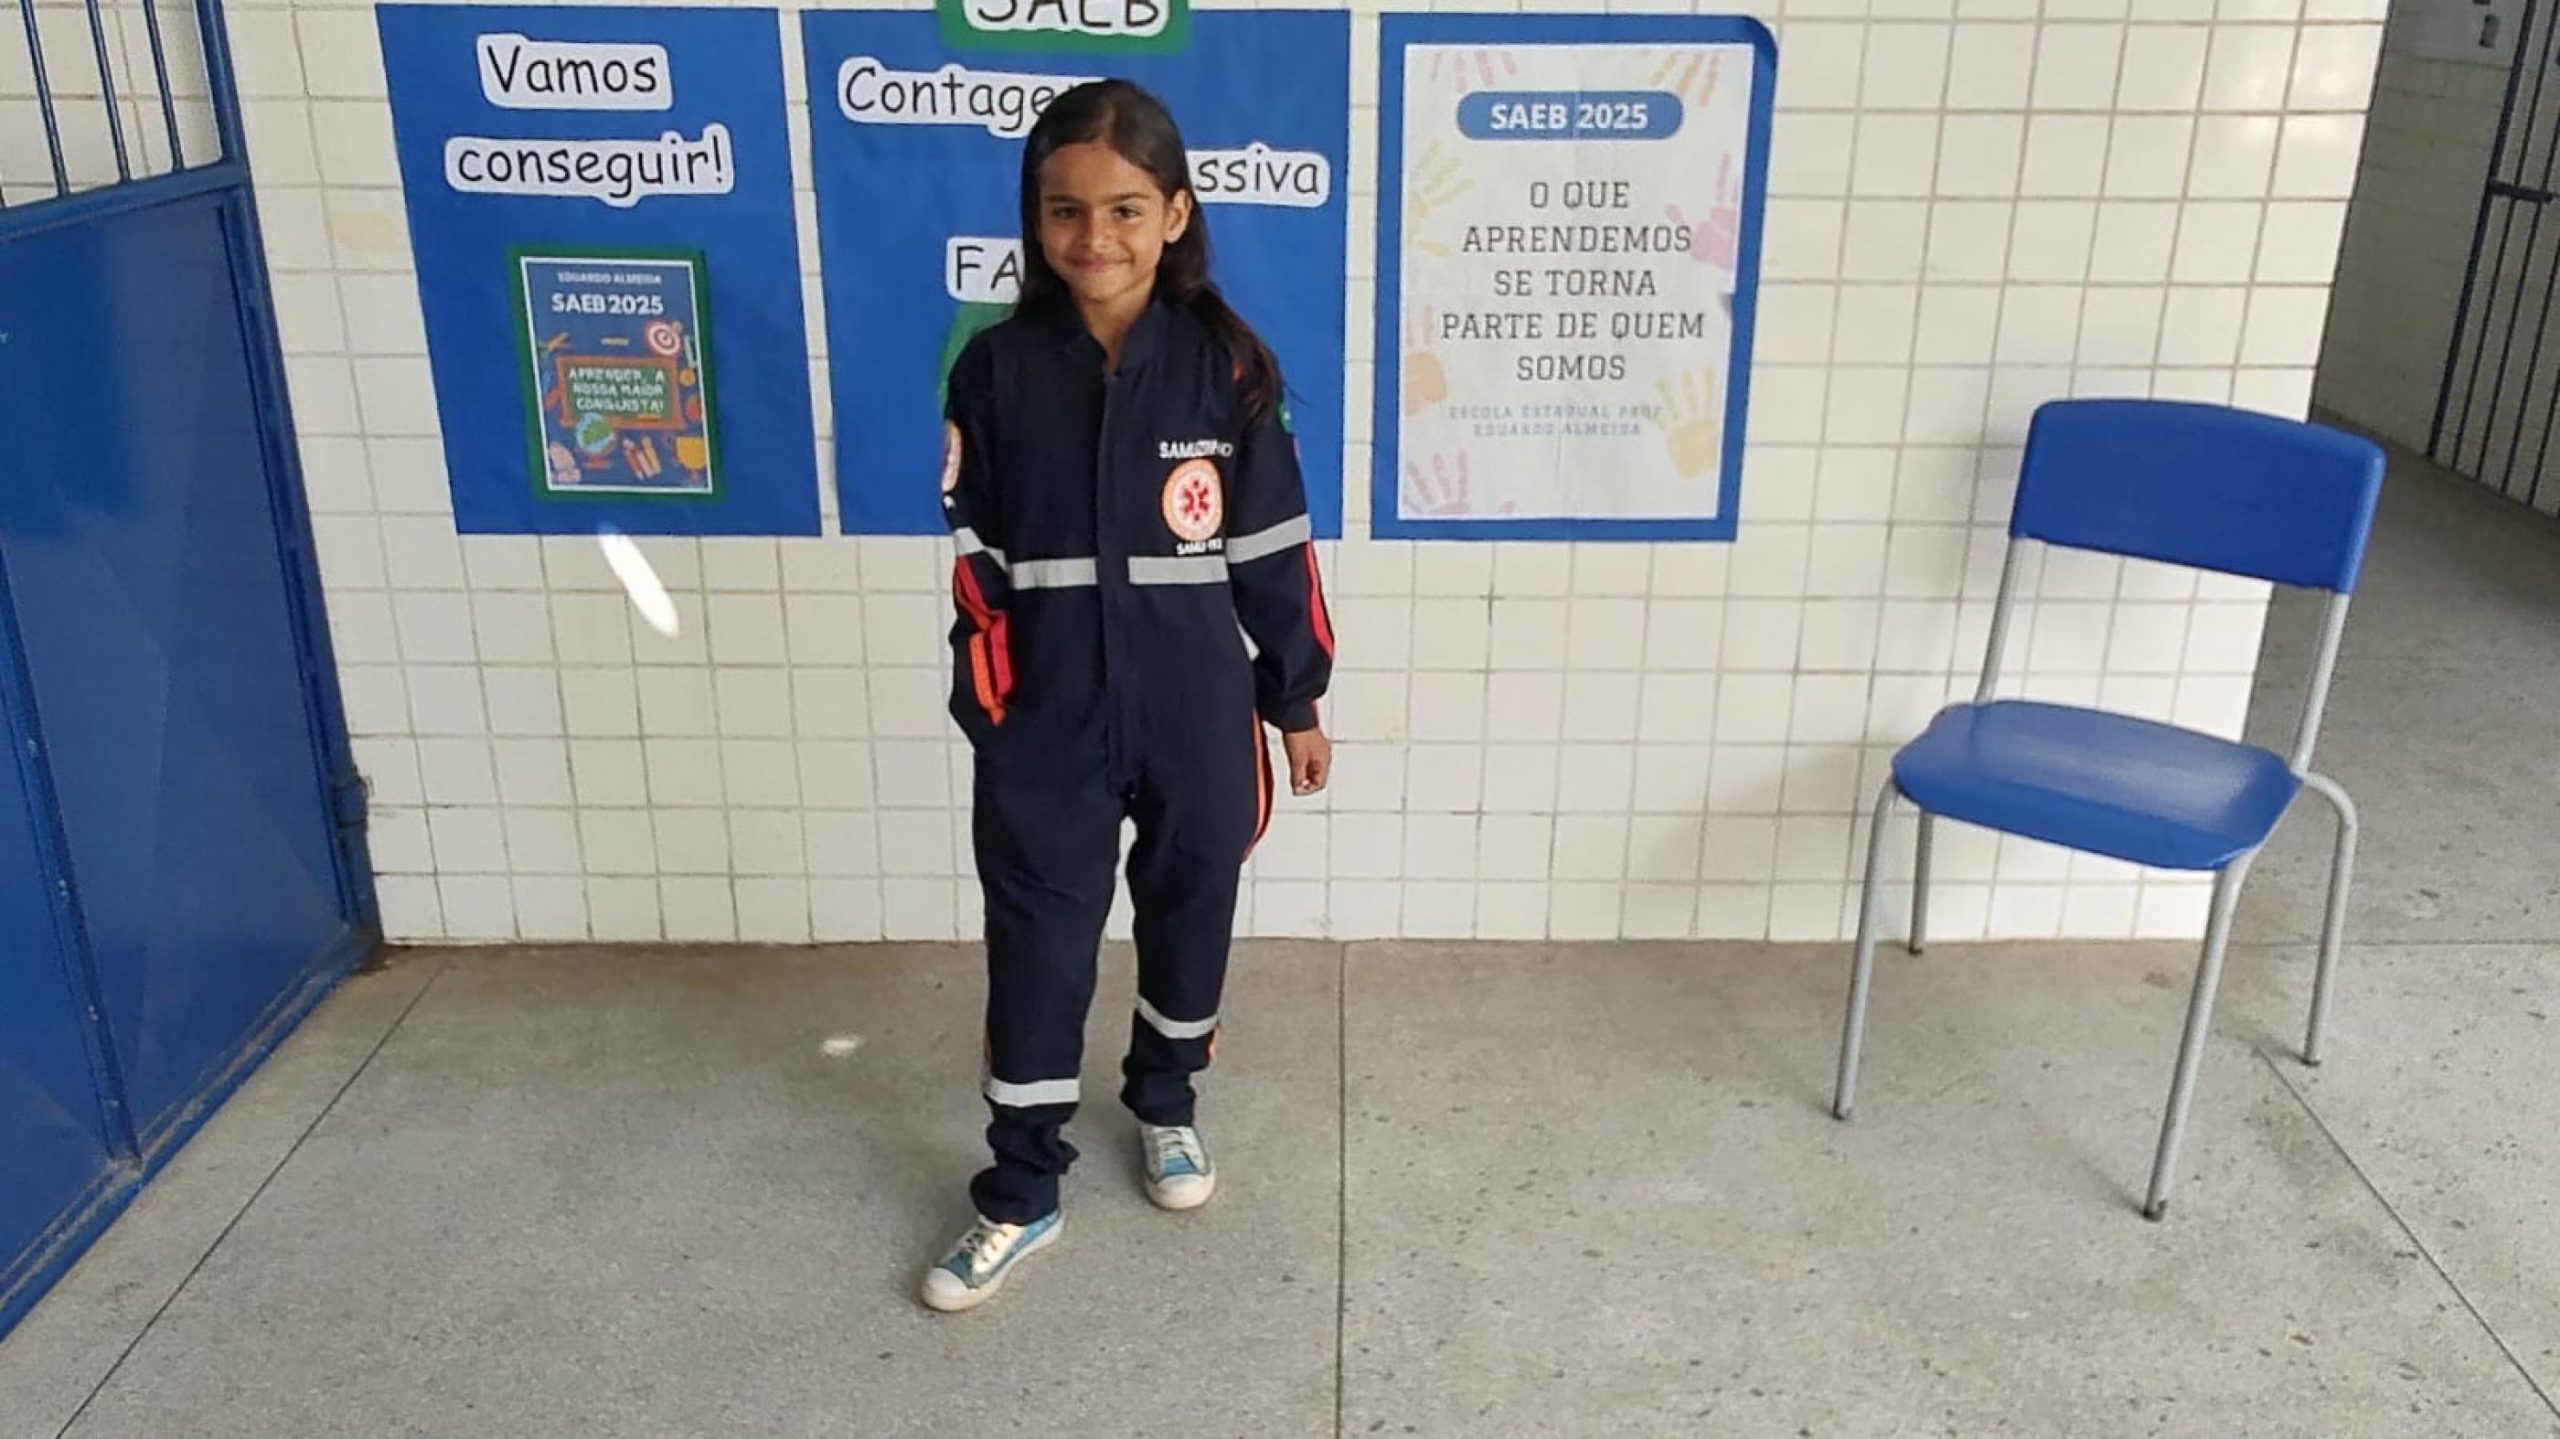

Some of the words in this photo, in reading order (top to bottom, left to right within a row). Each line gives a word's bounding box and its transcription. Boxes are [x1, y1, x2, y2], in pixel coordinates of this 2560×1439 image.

[487, 45, 658, 95] Vamos
[845, 66, 1076, 131] Contage
[1489, 103, 1568, 131] SAEB
[1576, 103, 1649, 130] 2025
[458, 136, 723, 198] conseguir!
[1195, 148, 1319, 194] ssiva
[1529, 181, 1550, 209] O
[1563, 181, 1630, 210] QUE
[1462, 225, 1692, 254] APRENDEMOS
[955, 244, 1025, 292] FA
[1493, 269, 1533, 297] SE
[1545, 269, 1657, 297] TORNA
[551, 292, 606, 313] SAEB
[607, 294, 664, 315] 2025
[1441, 312, 1543, 339] PARTE
[1556, 312, 1598, 339] DE
[1611, 312, 1704, 341] QUEM
[1516, 354, 1626, 381] SOMOS
[1449, 405, 1512, 419] ESCOLA
[1521, 405, 1610, 418] ESTADUAL
[1473, 423, 1554, 437] EDUARDO
[1561, 423, 1641, 436] ALMEIDA
